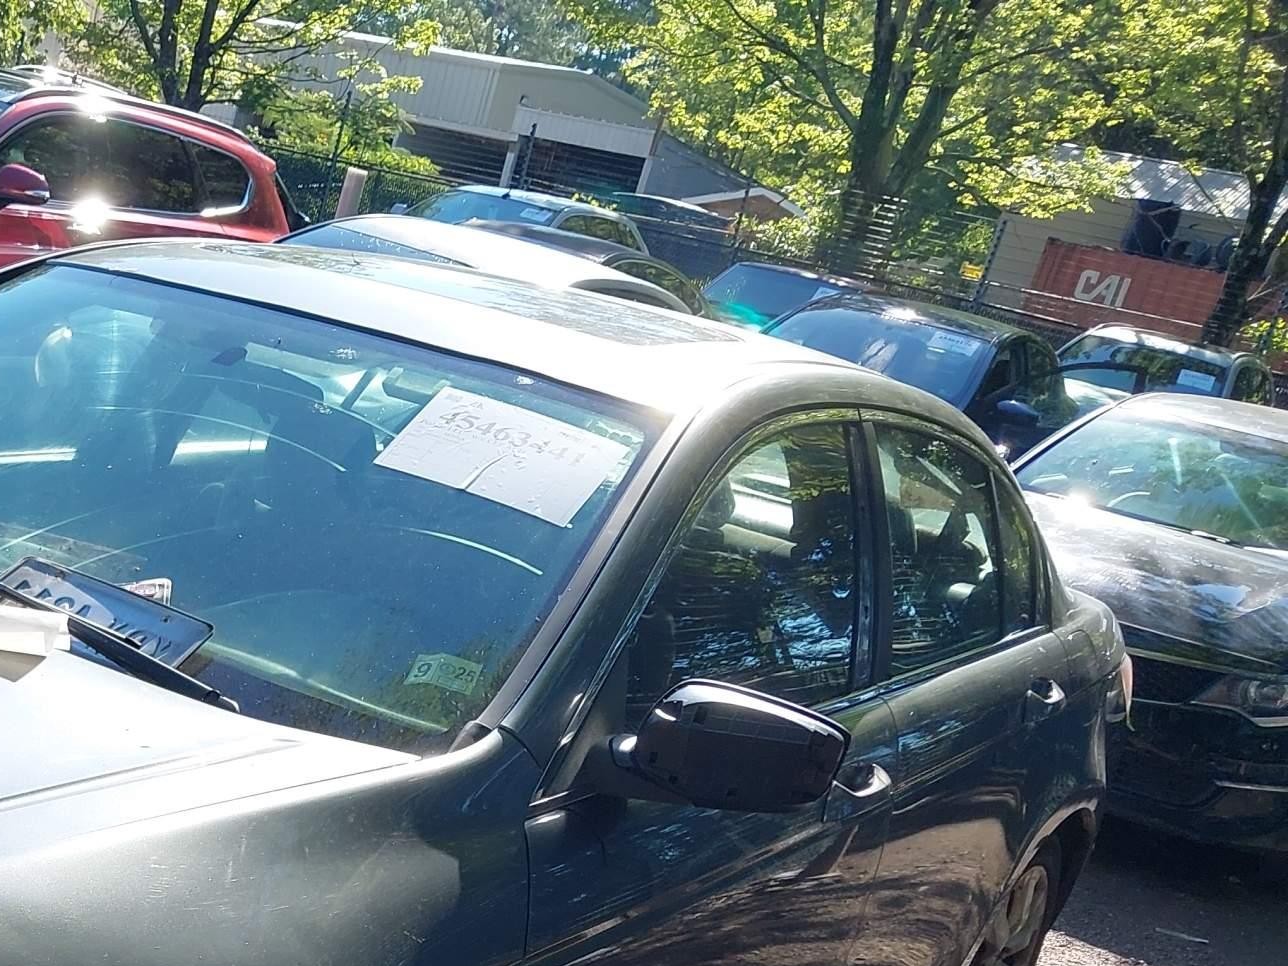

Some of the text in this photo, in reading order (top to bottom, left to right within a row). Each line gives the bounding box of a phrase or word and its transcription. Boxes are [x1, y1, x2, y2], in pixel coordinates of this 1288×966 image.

[1074, 269, 1132, 307] CAI
[440, 409, 585, 466] 45463441
[413, 662, 433, 678] 9
[454, 666, 477, 683] 25
